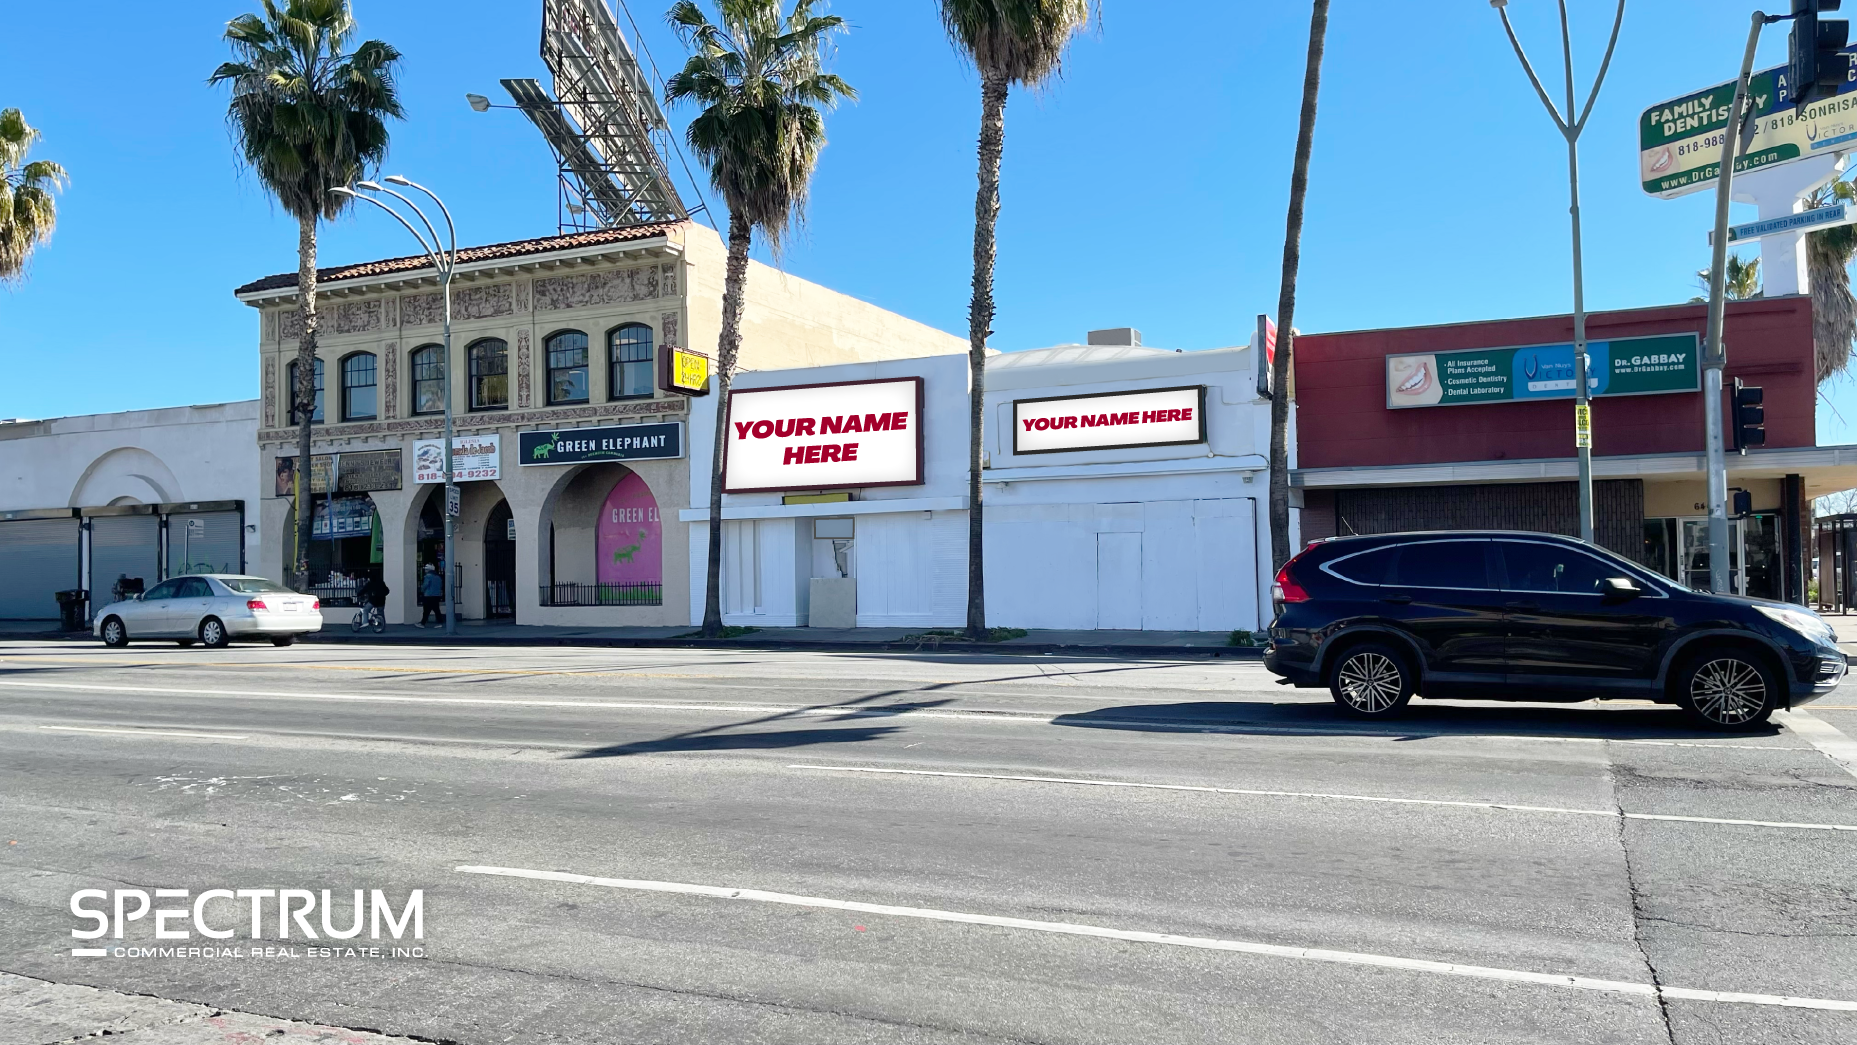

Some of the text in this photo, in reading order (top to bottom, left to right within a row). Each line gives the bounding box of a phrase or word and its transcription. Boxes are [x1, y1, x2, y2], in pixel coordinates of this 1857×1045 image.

[1651, 95, 1713, 125] FAMILY
[1664, 94, 1767, 136] DENTISY
[1661, 152, 1778, 190] www.DrGaay.com
[1740, 208, 1841, 236] FREE VALIDATED PARKING IN REAR
[681, 355, 700, 371] OPEN
[1457, 359, 1489, 367] Insurance
[1631, 353, 1686, 366] GABBAY
[1466, 365, 1496, 373] Accepted
[1447, 375, 1507, 385] Cosmetic Dentistry
[1448, 386, 1505, 396] Dental Laboratory
[735, 412, 908, 440] YOUR NAME
[1022, 408, 1193, 431] YOUR NAME HERE
[557, 435, 666, 453] GREEN ELEPHANT
[783, 443, 859, 465] HERE
[417, 469, 497, 481] 818-4-9232
[449, 500, 459, 514] 35
[612, 508, 644, 523] GREEN
